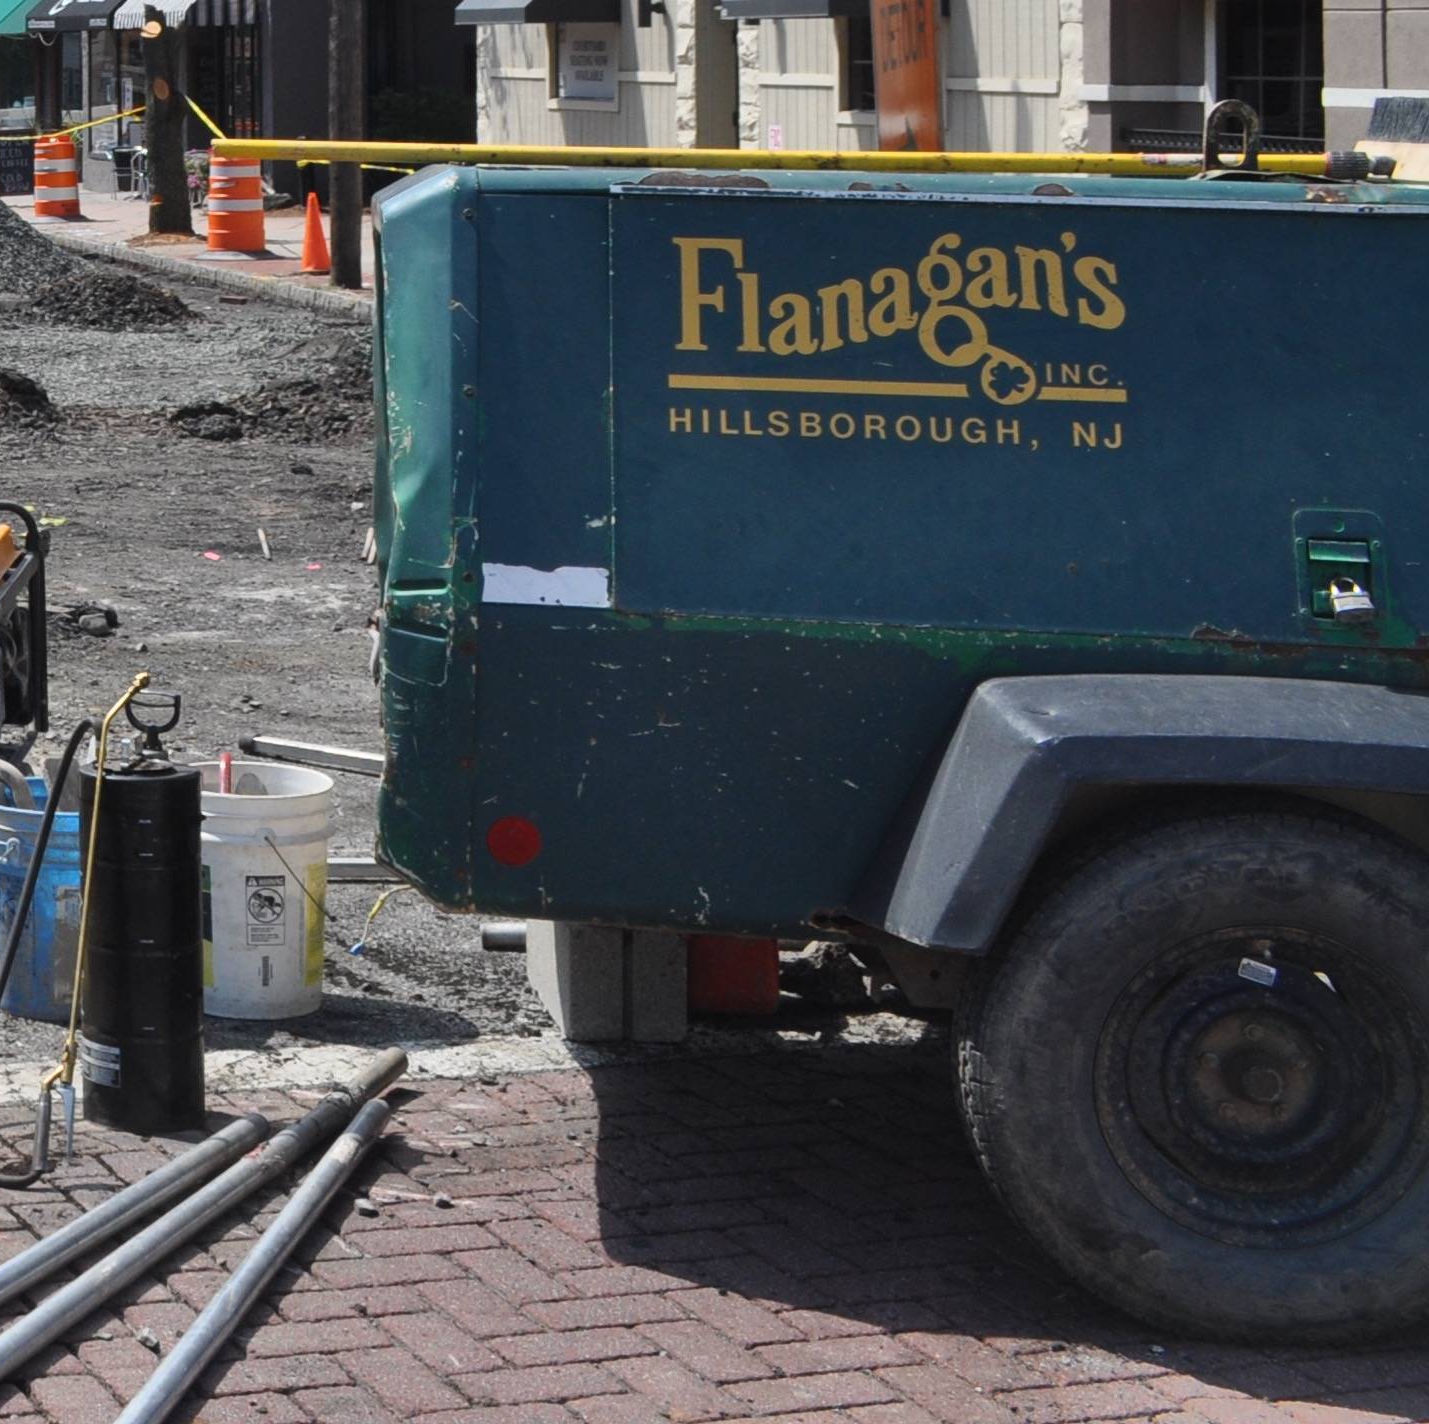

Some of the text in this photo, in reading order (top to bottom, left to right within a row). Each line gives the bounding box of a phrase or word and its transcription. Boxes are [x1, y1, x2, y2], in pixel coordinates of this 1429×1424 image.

[672, 231, 1126, 367] Flanagan's
[1044, 362, 1125, 387] INC.
[668, 407, 1123, 451] HILLSBOROUGH, NJ
